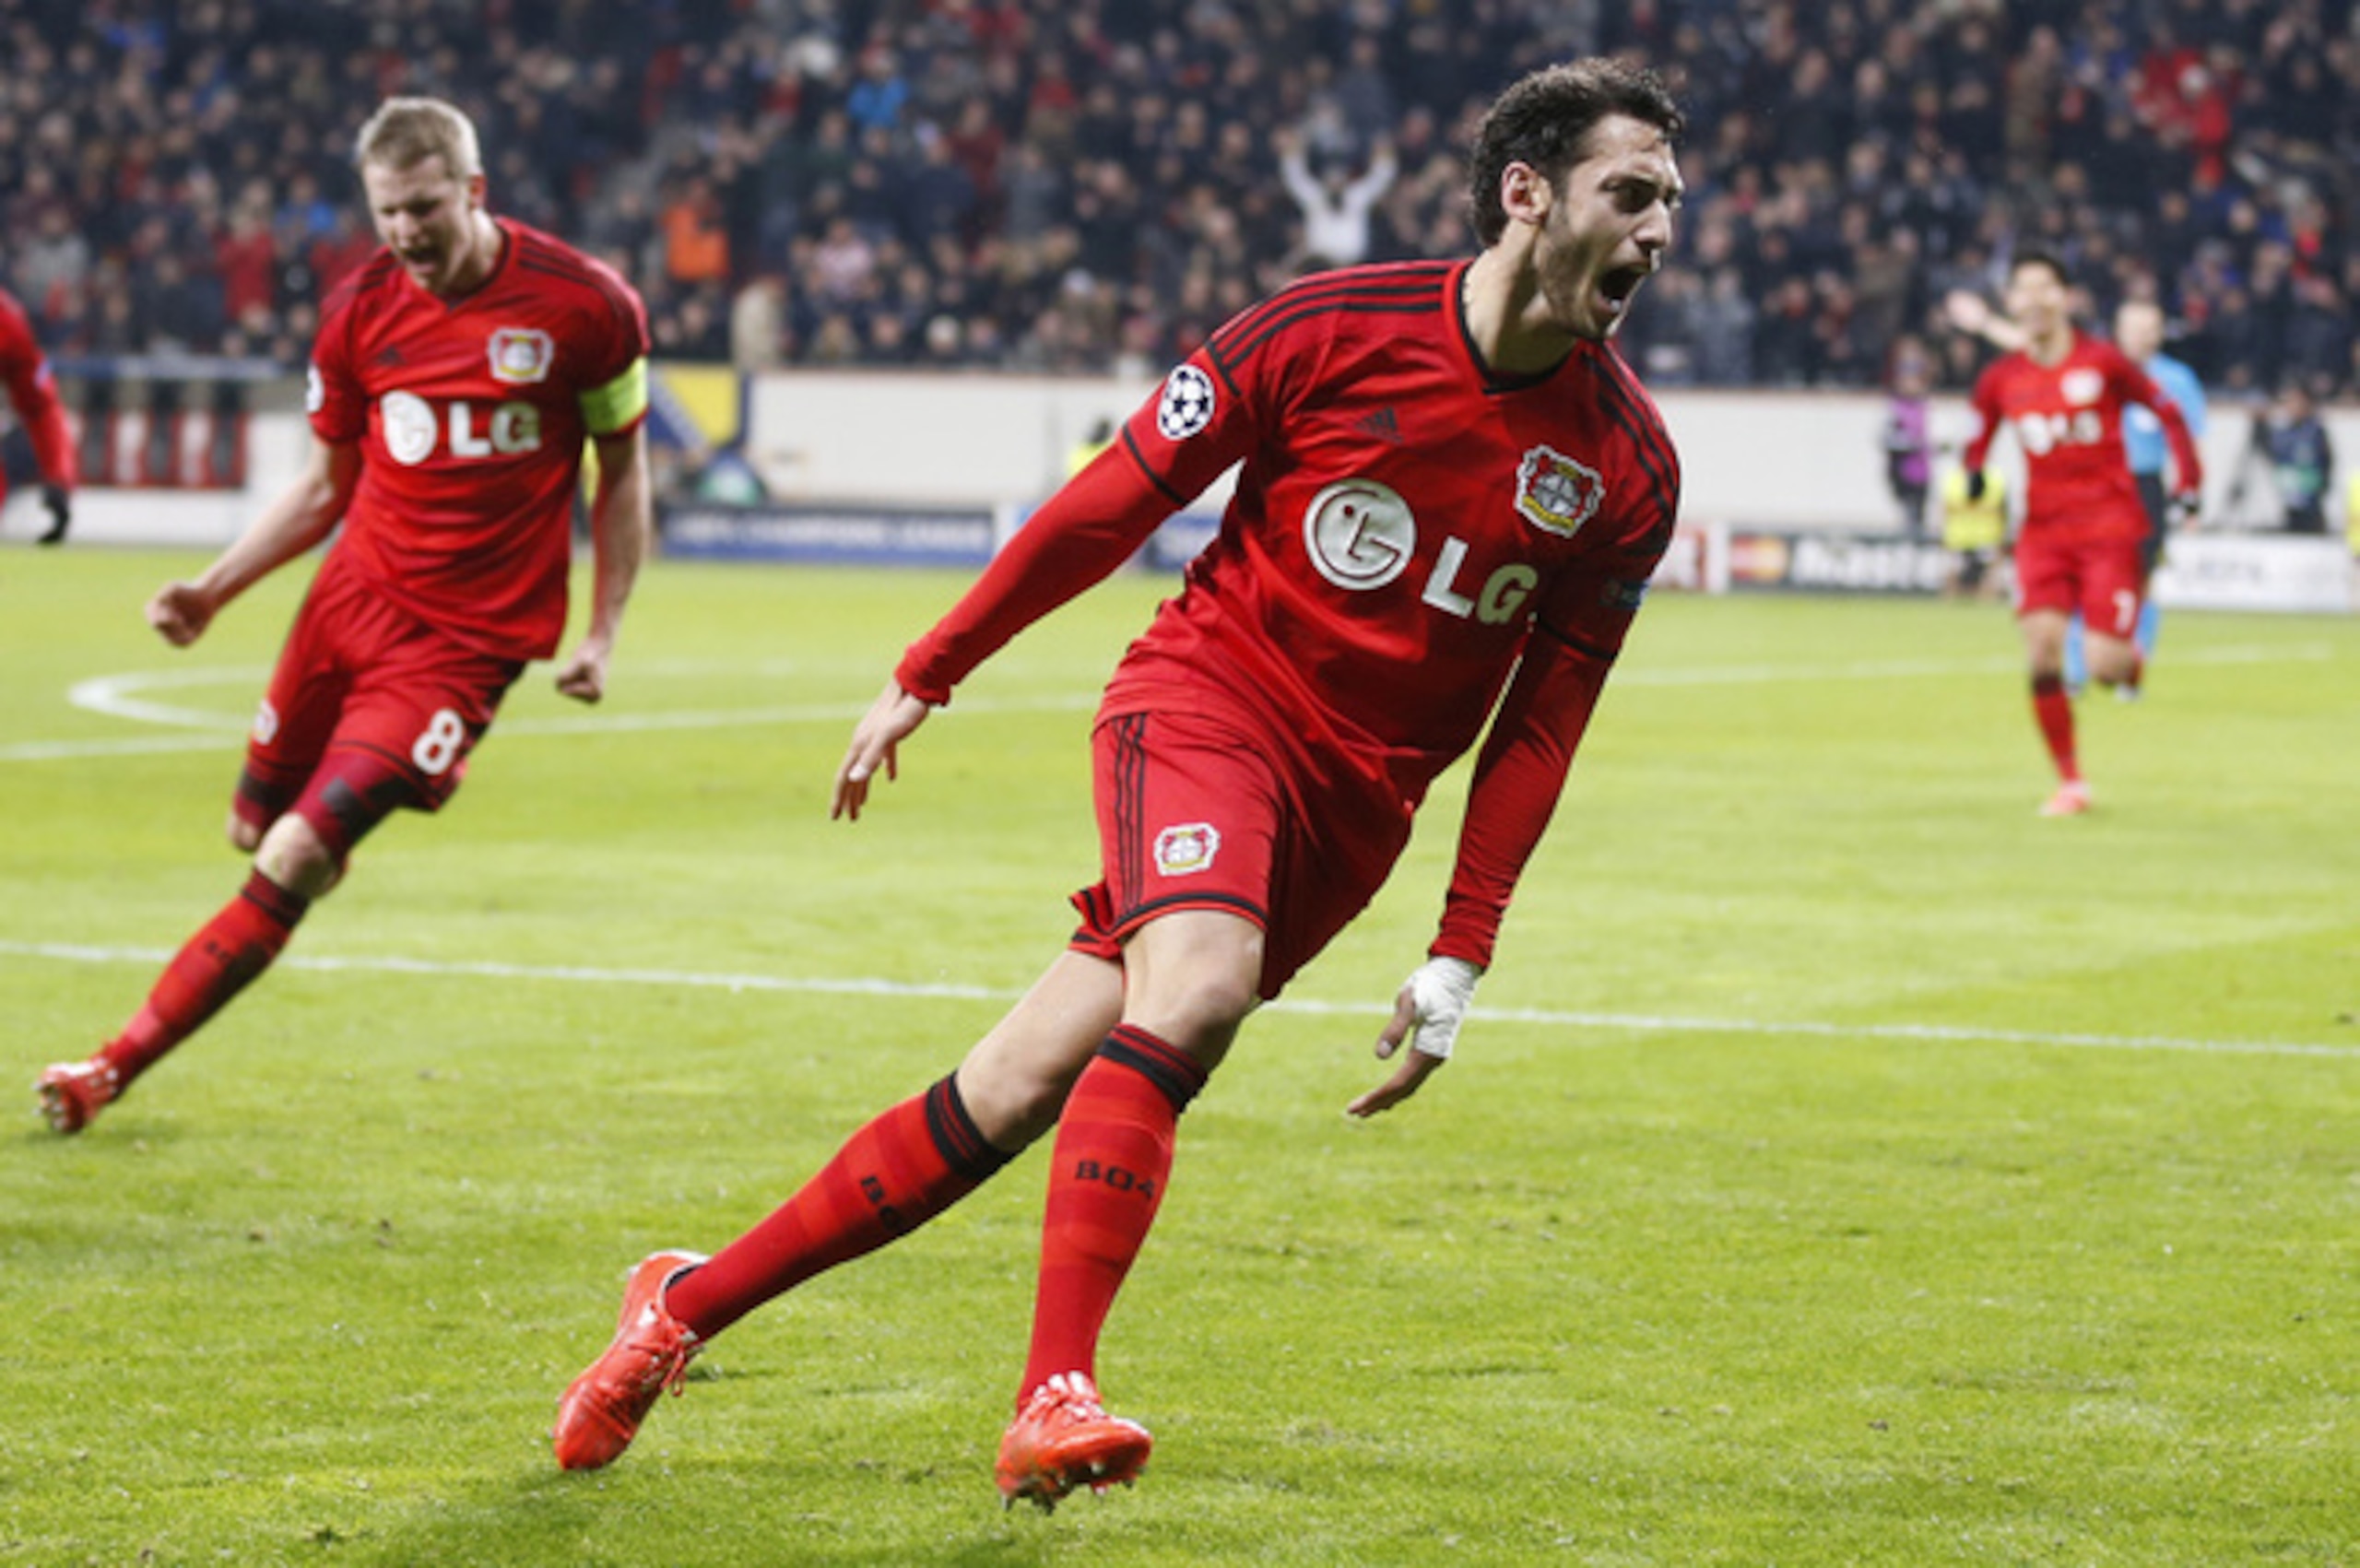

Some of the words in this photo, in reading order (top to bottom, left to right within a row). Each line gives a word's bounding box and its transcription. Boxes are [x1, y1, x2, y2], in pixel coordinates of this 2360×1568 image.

[449, 401, 541, 456] LG
[1422, 535, 1539, 623] LG
[2112, 589, 2136, 633] 7
[411, 706, 464, 775] 8
